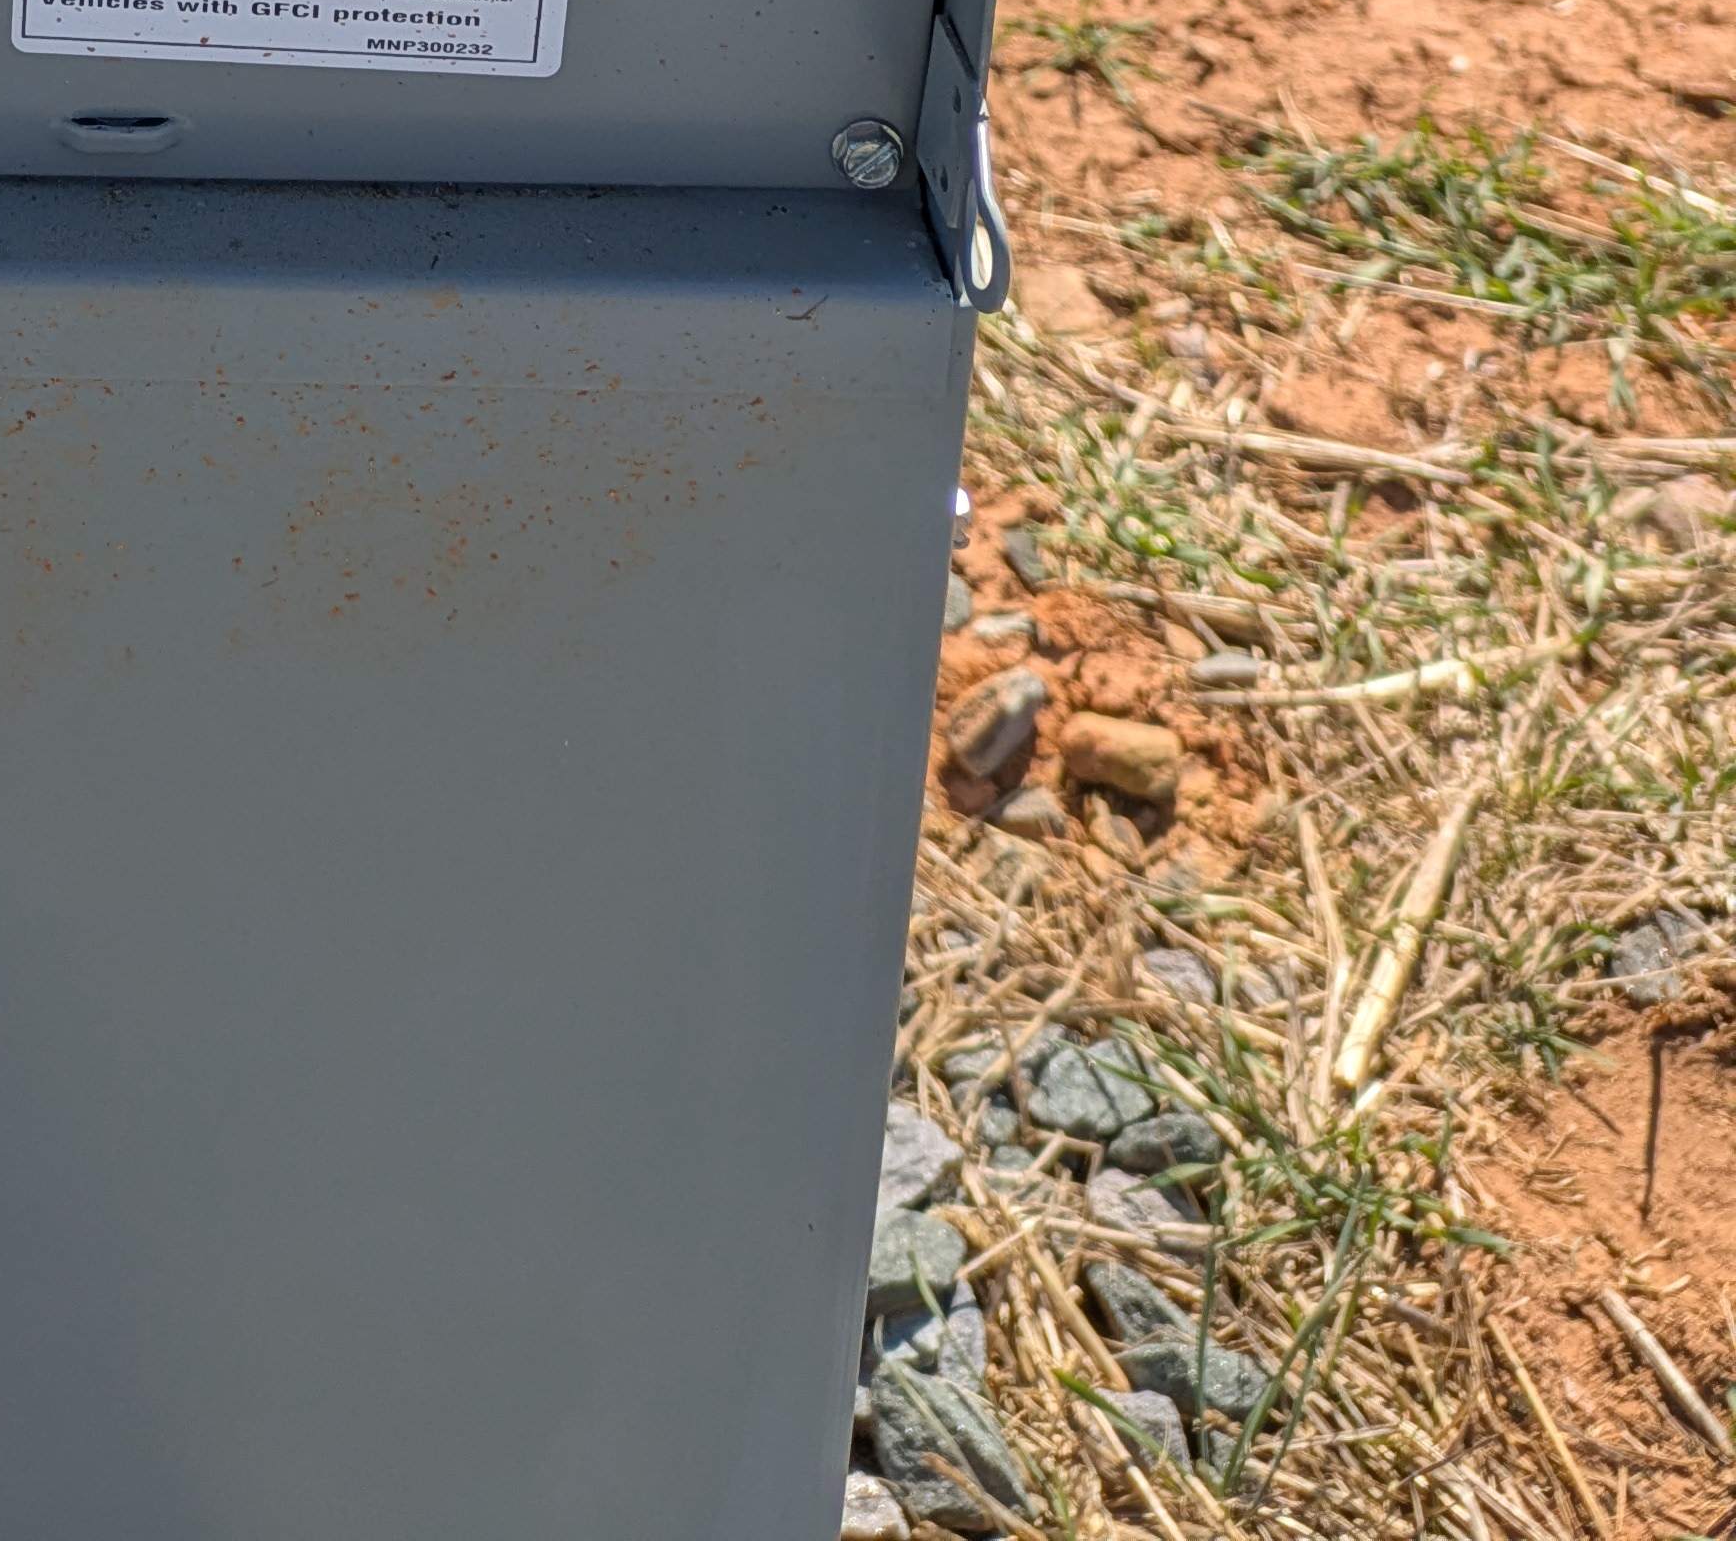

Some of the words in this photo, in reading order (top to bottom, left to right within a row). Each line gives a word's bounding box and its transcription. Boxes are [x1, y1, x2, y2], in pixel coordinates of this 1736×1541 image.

[177, 0, 237, 16] with
[252, 2, 319, 18] GFCI
[334, 9, 480, 26] protection
[366, 39, 493, 56] MNP300232
